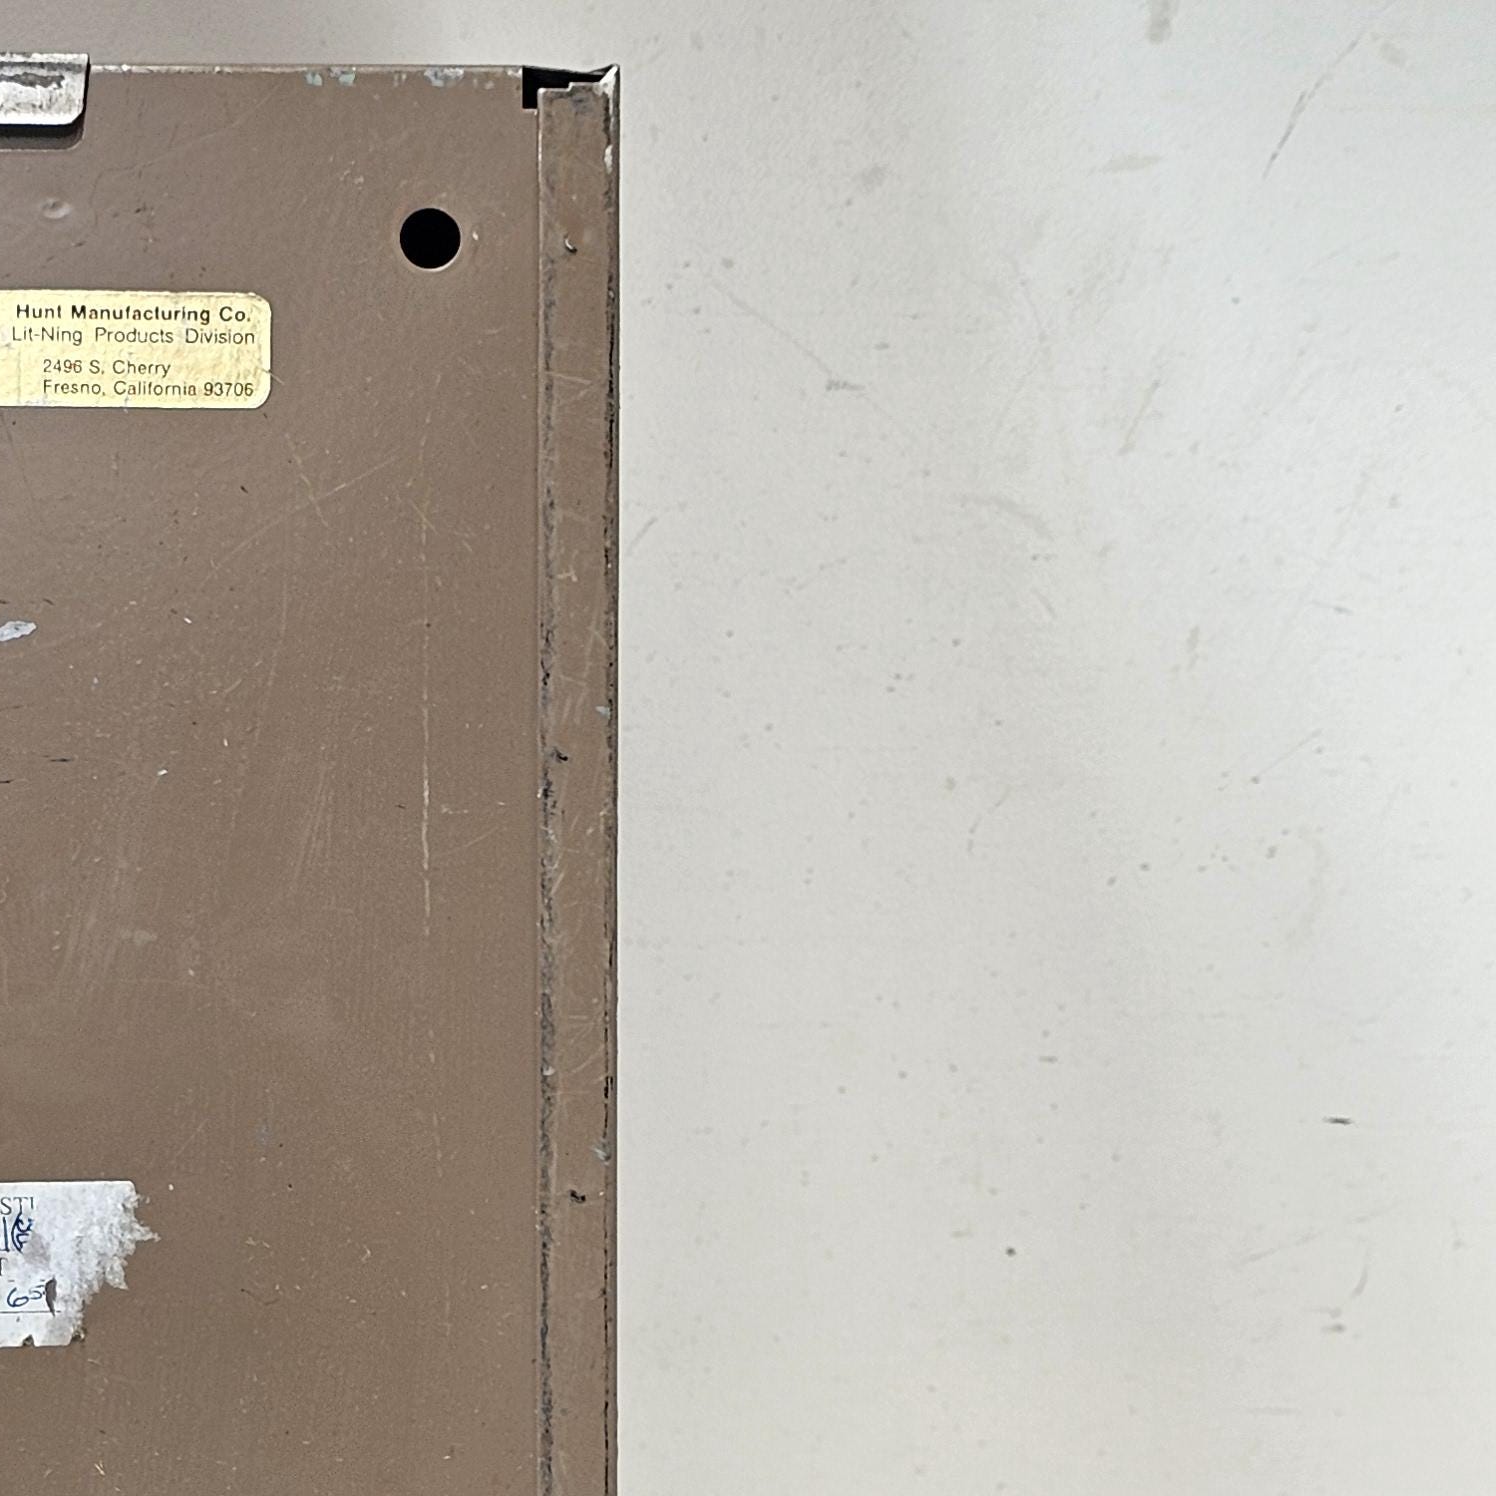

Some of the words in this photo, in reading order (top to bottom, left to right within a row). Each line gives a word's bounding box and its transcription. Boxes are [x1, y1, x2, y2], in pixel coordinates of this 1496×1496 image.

[16, 304, 62, 319] Hunt
[71, 304, 211, 325] Manufacturing
[219, 306, 251, 322] Co.
[12, 326, 83, 346] Lit-Ning
[95, 327, 174, 344] Products
[185, 328, 255, 345] Division
[43, 359, 83, 374] 2496
[112, 360, 172, 379] Cherry
[43, 380, 106, 397] Fresno,
[113, 380, 197, 397] California
[204, 382, 255, 398] 93706
